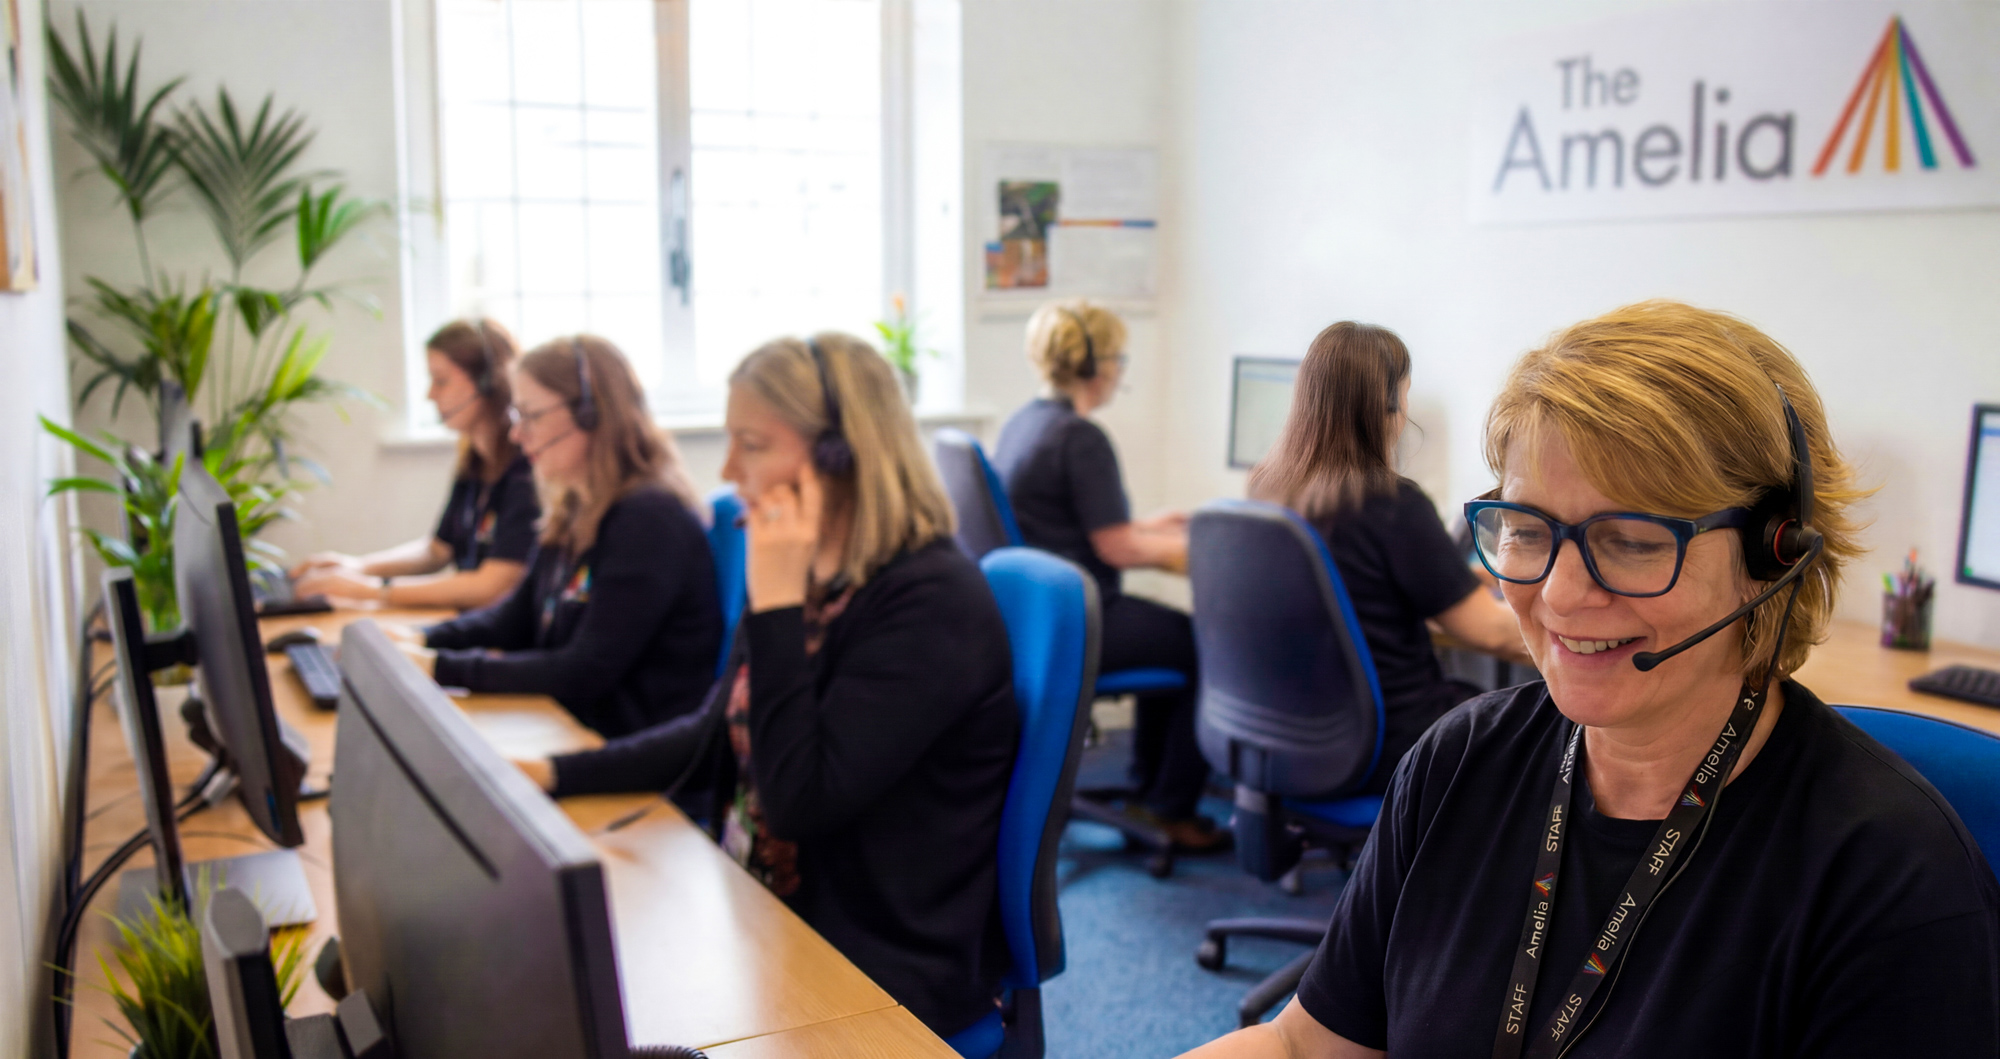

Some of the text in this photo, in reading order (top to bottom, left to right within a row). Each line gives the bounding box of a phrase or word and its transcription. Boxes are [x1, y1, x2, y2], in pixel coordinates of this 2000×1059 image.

[1556, 55, 1639, 109] The
[1493, 80, 1795, 192] Amelia
[1695, 722, 1737, 784] Amelia
[1648, 828, 1681, 876] STAFF
[1526, 901, 1549, 959] Amelia
[1597, 892, 1636, 951] Amelia
[1506, 983, 1527, 1035] STAFF
